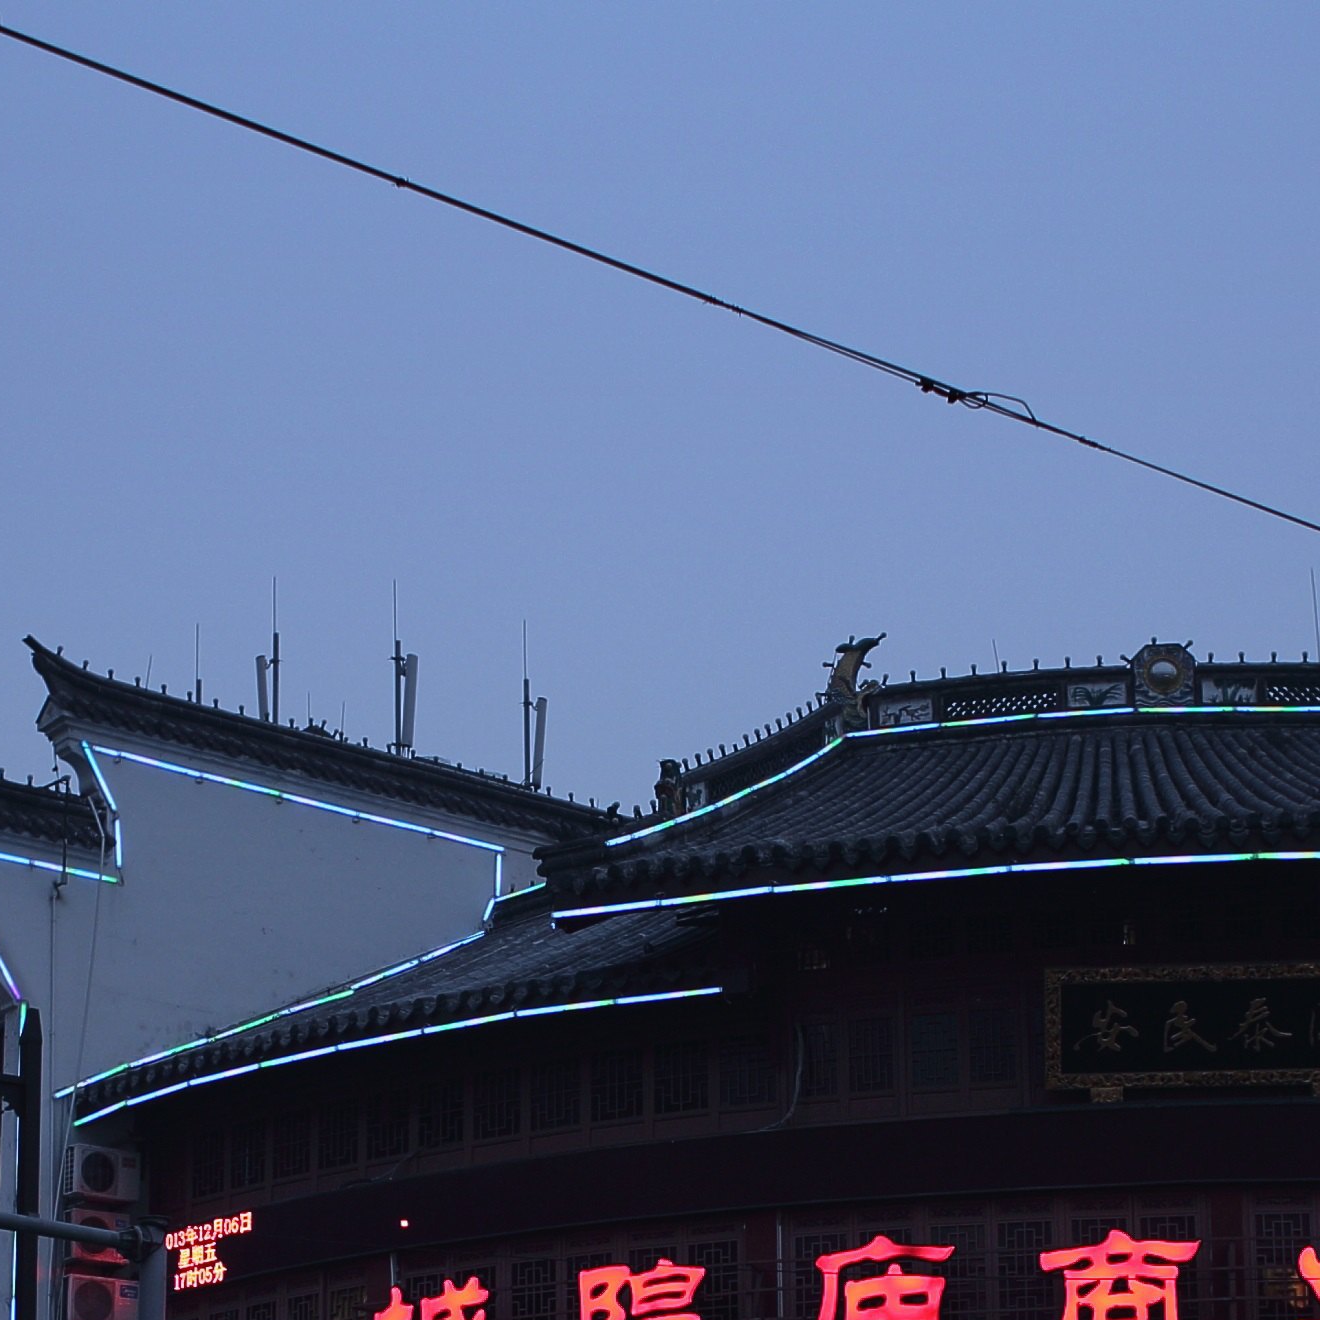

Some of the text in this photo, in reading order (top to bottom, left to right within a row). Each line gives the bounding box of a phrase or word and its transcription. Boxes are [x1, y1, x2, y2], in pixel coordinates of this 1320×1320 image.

[177, 1241, 218, 1269] 星期五
[173, 1261, 227, 1290] 17时05分
